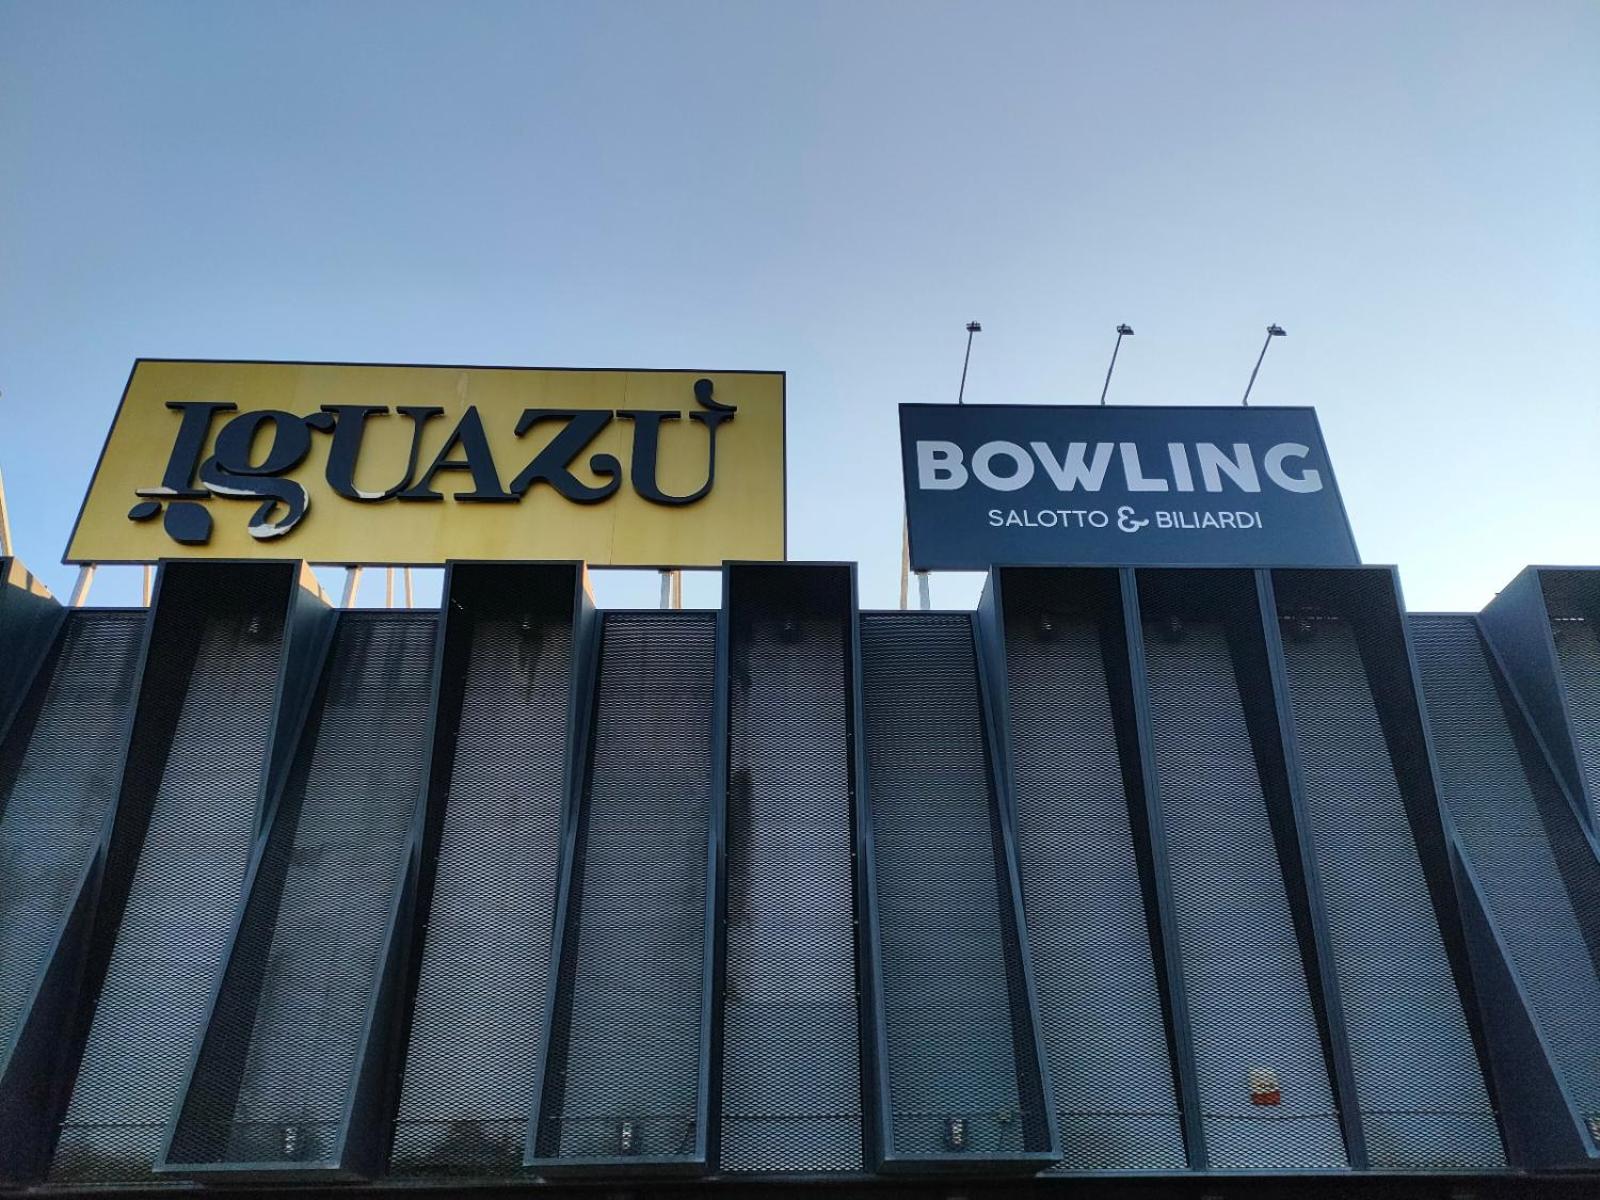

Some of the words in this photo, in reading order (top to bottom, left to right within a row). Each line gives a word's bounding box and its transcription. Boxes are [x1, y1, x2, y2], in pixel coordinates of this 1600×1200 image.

[916, 440, 1323, 494] BOWLING
[988, 509, 1109, 529] SALOTTO
[1117, 505, 1149, 533] &
[1157, 511, 1263, 530] BILIARDI
